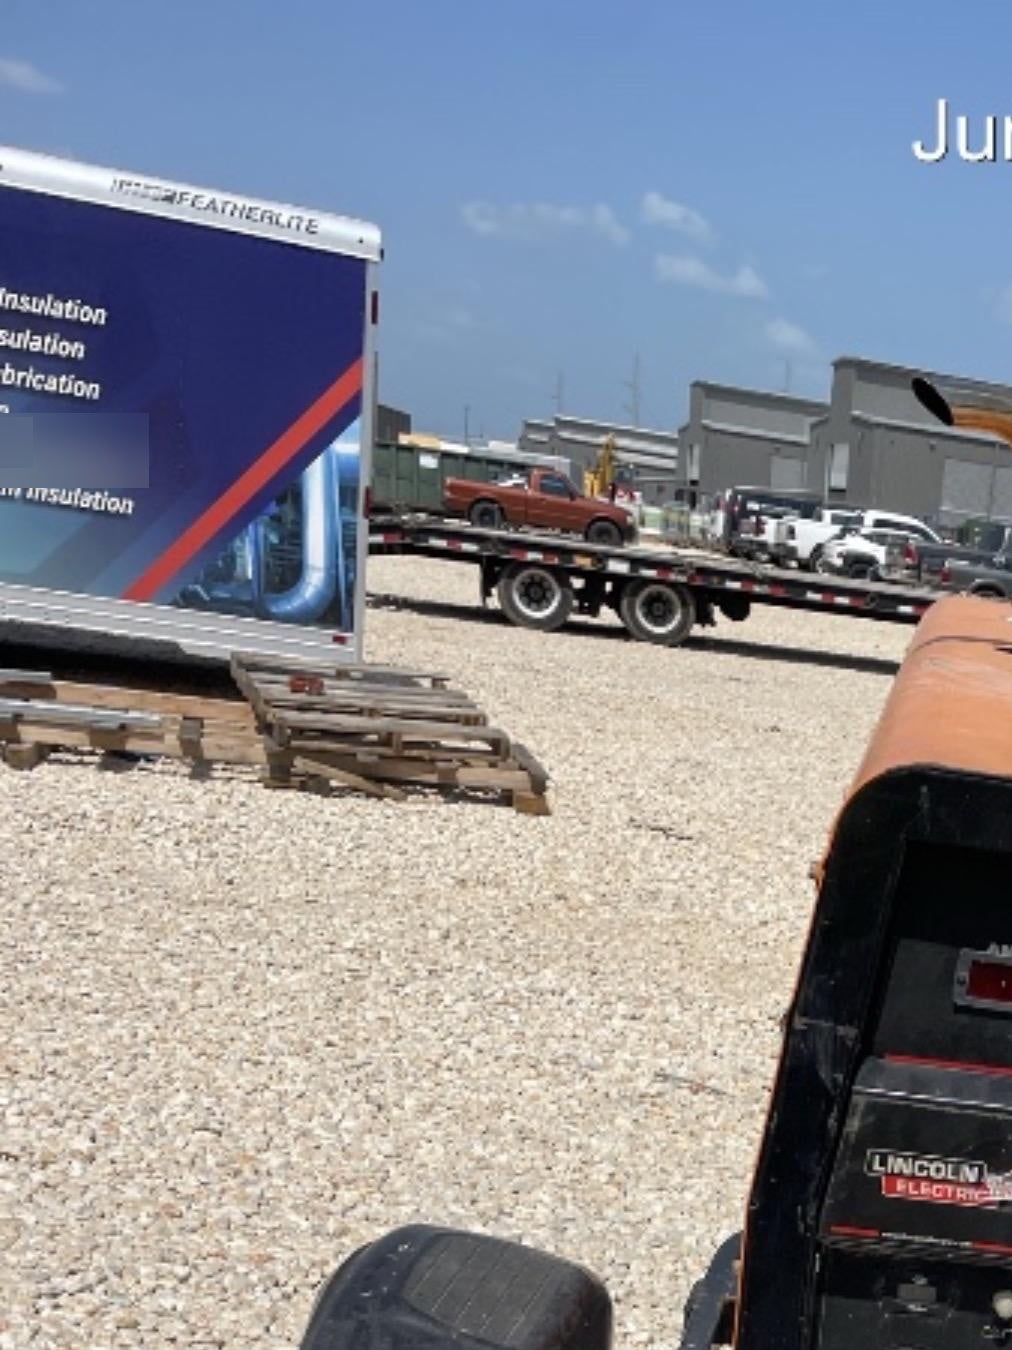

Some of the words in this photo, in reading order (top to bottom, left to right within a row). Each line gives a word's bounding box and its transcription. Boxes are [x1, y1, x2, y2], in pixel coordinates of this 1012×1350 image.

[173, 190, 320, 235] FEATHERLITE
[0, 362, 101, 400] brication
[871, 1153, 980, 1183] LINCOLN
